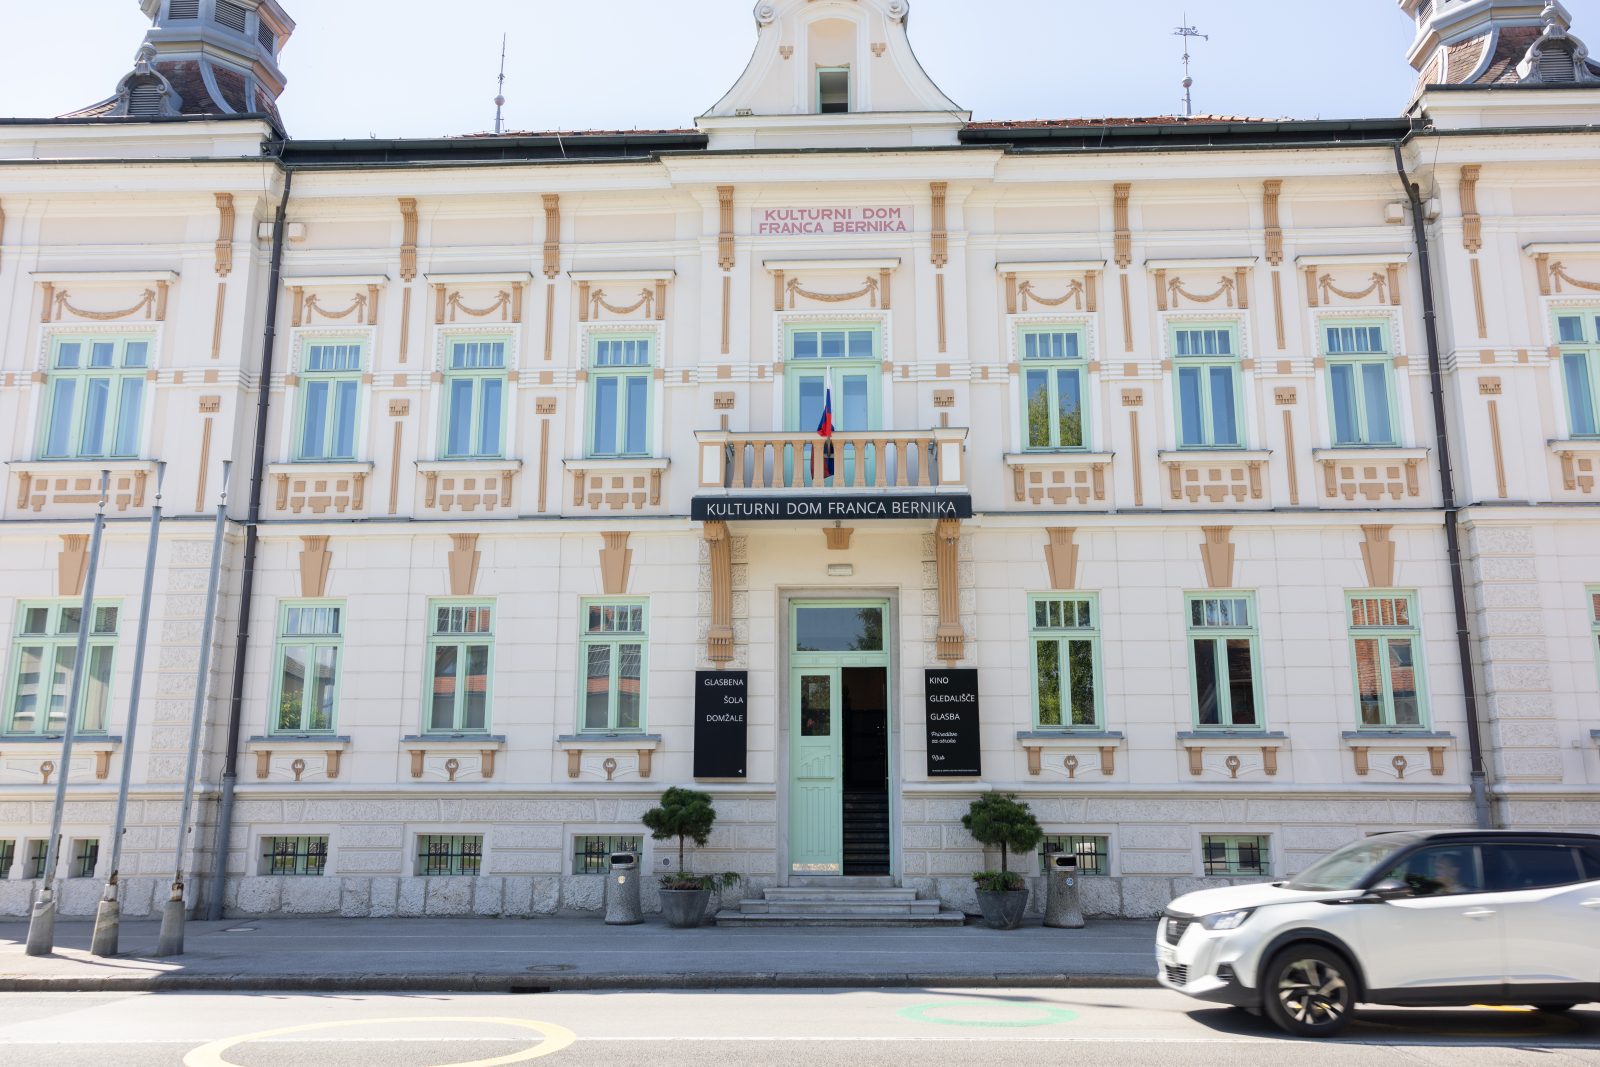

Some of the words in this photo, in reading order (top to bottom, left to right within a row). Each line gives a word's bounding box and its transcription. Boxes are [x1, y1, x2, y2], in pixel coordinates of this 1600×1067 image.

[764, 209, 852, 221] KULTURNI
[863, 207, 901, 219] DOM
[759, 222, 824, 234] FRANCA
[833, 220, 906, 233] BERNIKA
[706, 502, 780, 515] KULTURNI
[787, 502, 822, 515] DOM
[828, 502, 887, 515] FRANCA
[892, 501, 956, 514] BERNIKA
[704, 678, 744, 686] GLASBENA
[929, 676, 949, 684] KINO
[723, 695, 744, 704] ŠOLA
[929, 693, 975, 702] GLEDALIŠČE
[706, 713, 744, 722] DOMŽALE
[930, 713, 960, 721] GLASBA
